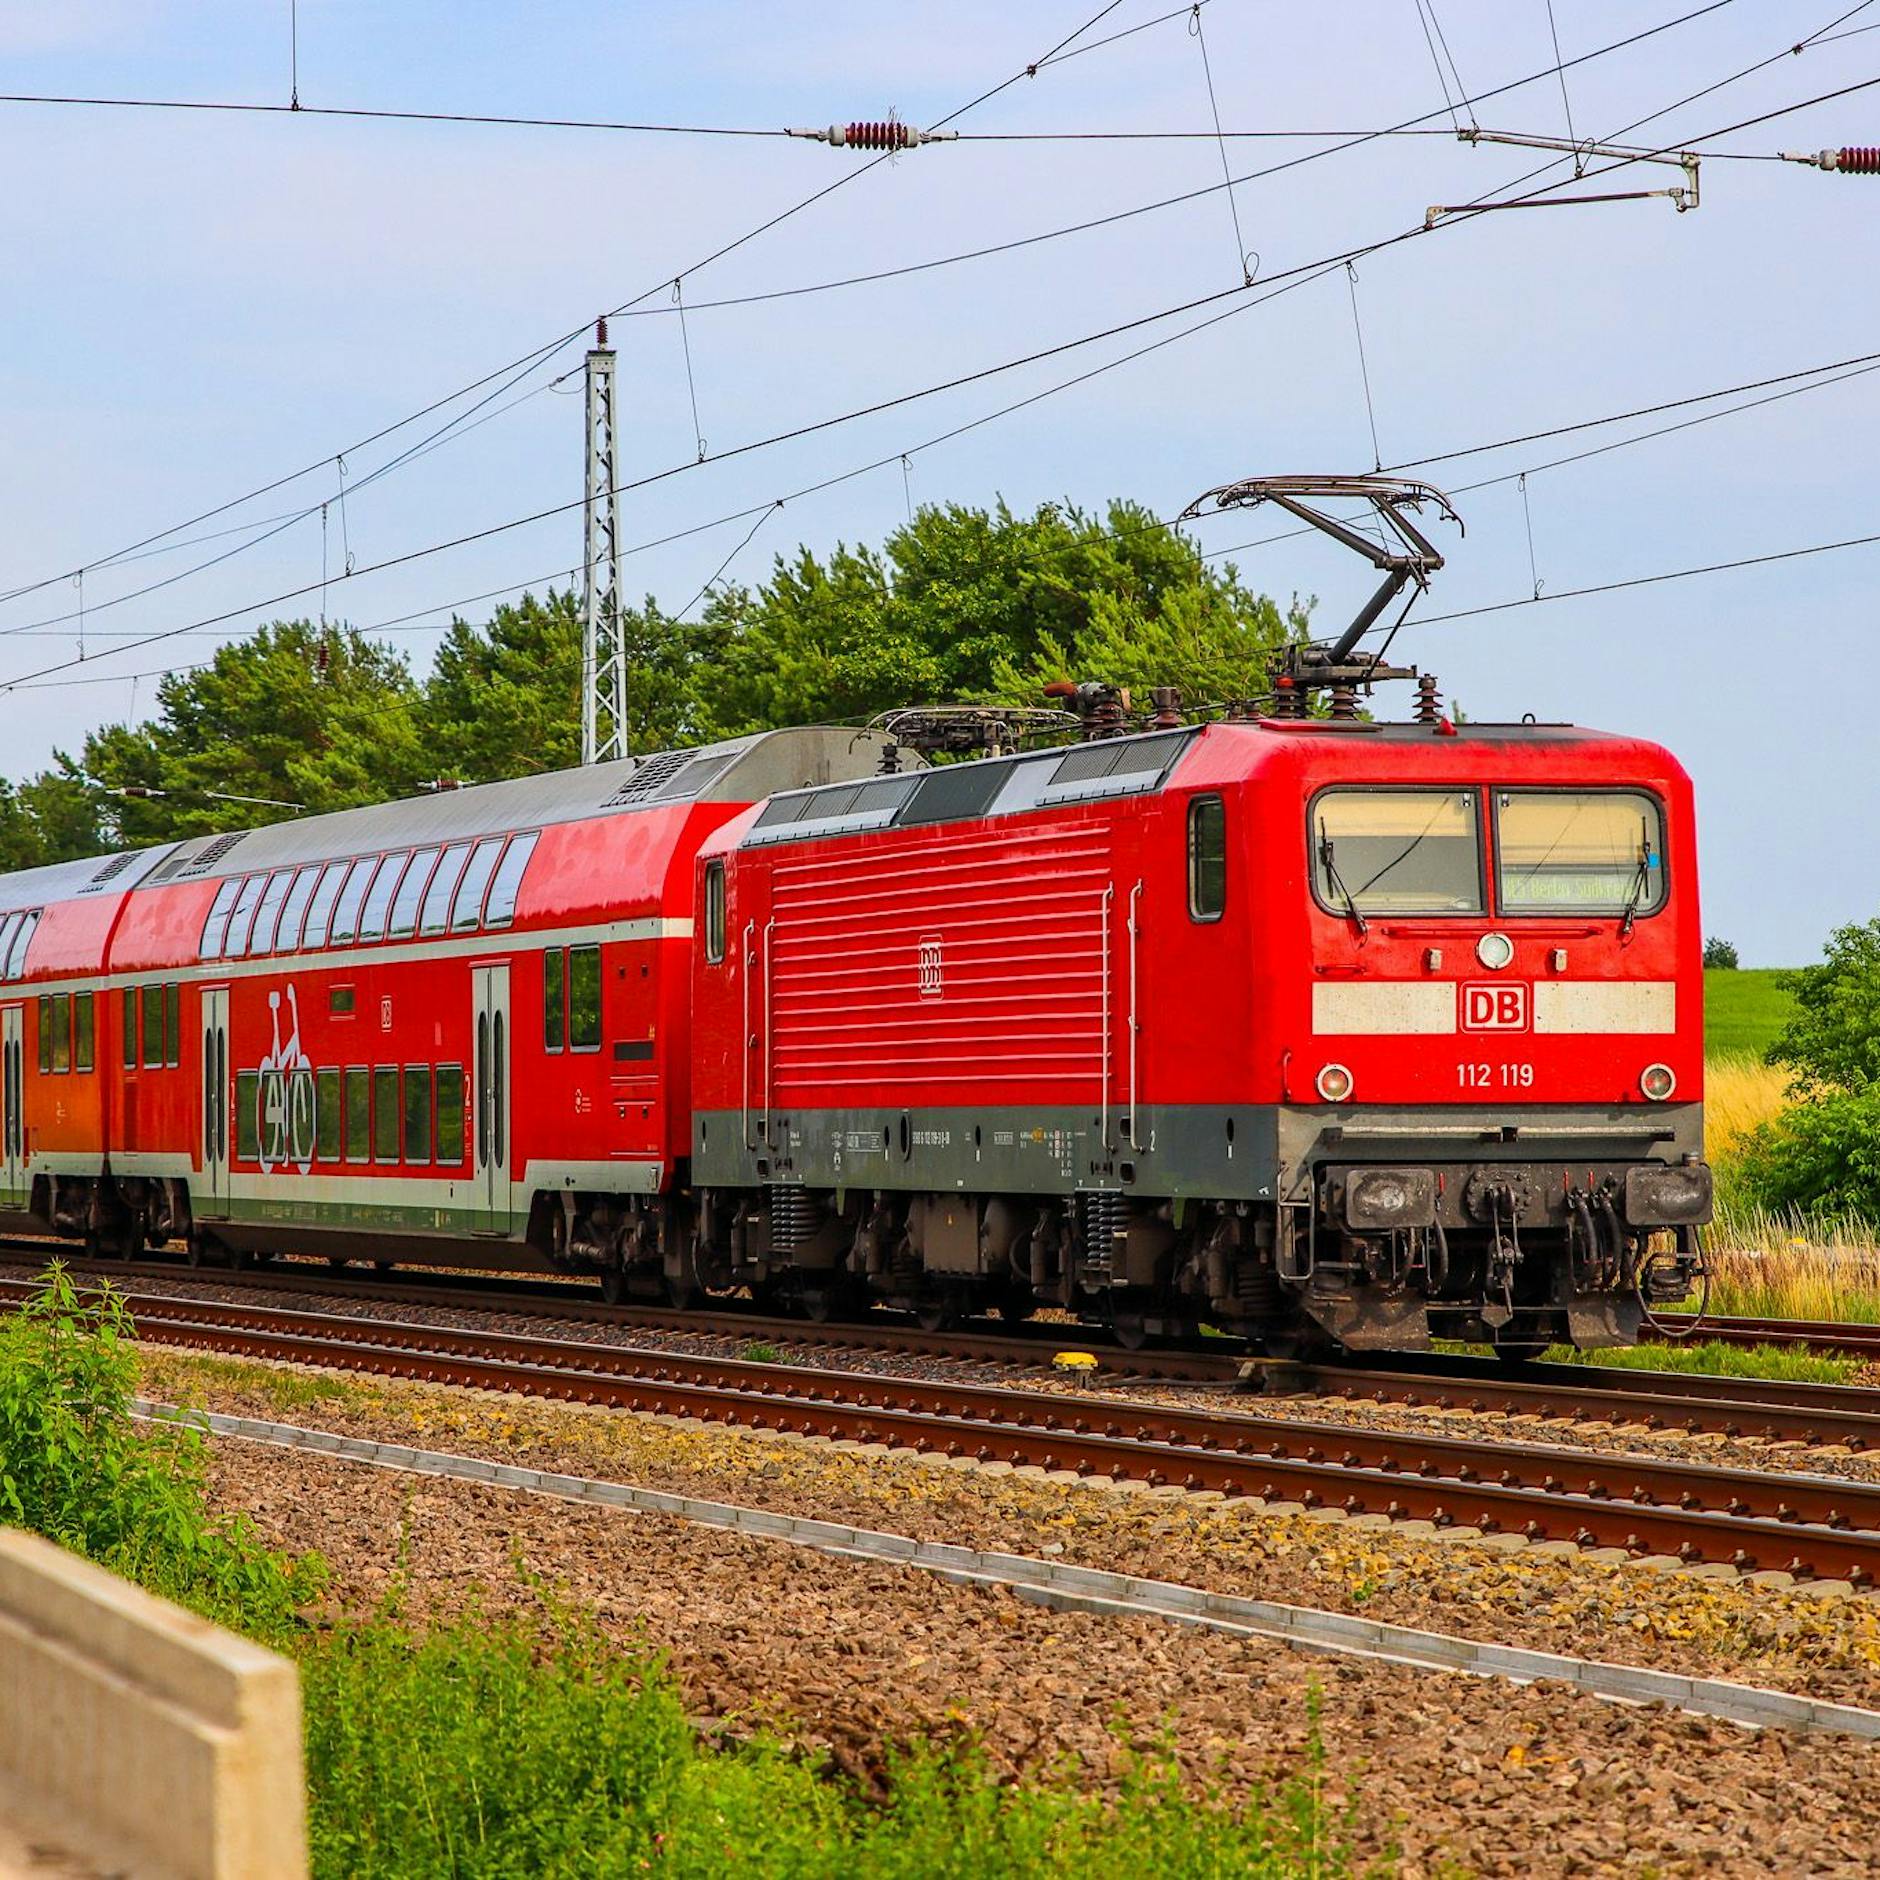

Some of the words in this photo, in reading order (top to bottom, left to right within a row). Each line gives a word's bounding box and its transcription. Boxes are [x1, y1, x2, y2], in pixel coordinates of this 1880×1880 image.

[1470, 991, 1520, 1024] DB
[1457, 1063, 1491, 1087] 112
[1500, 1063, 1534, 1087] 119
